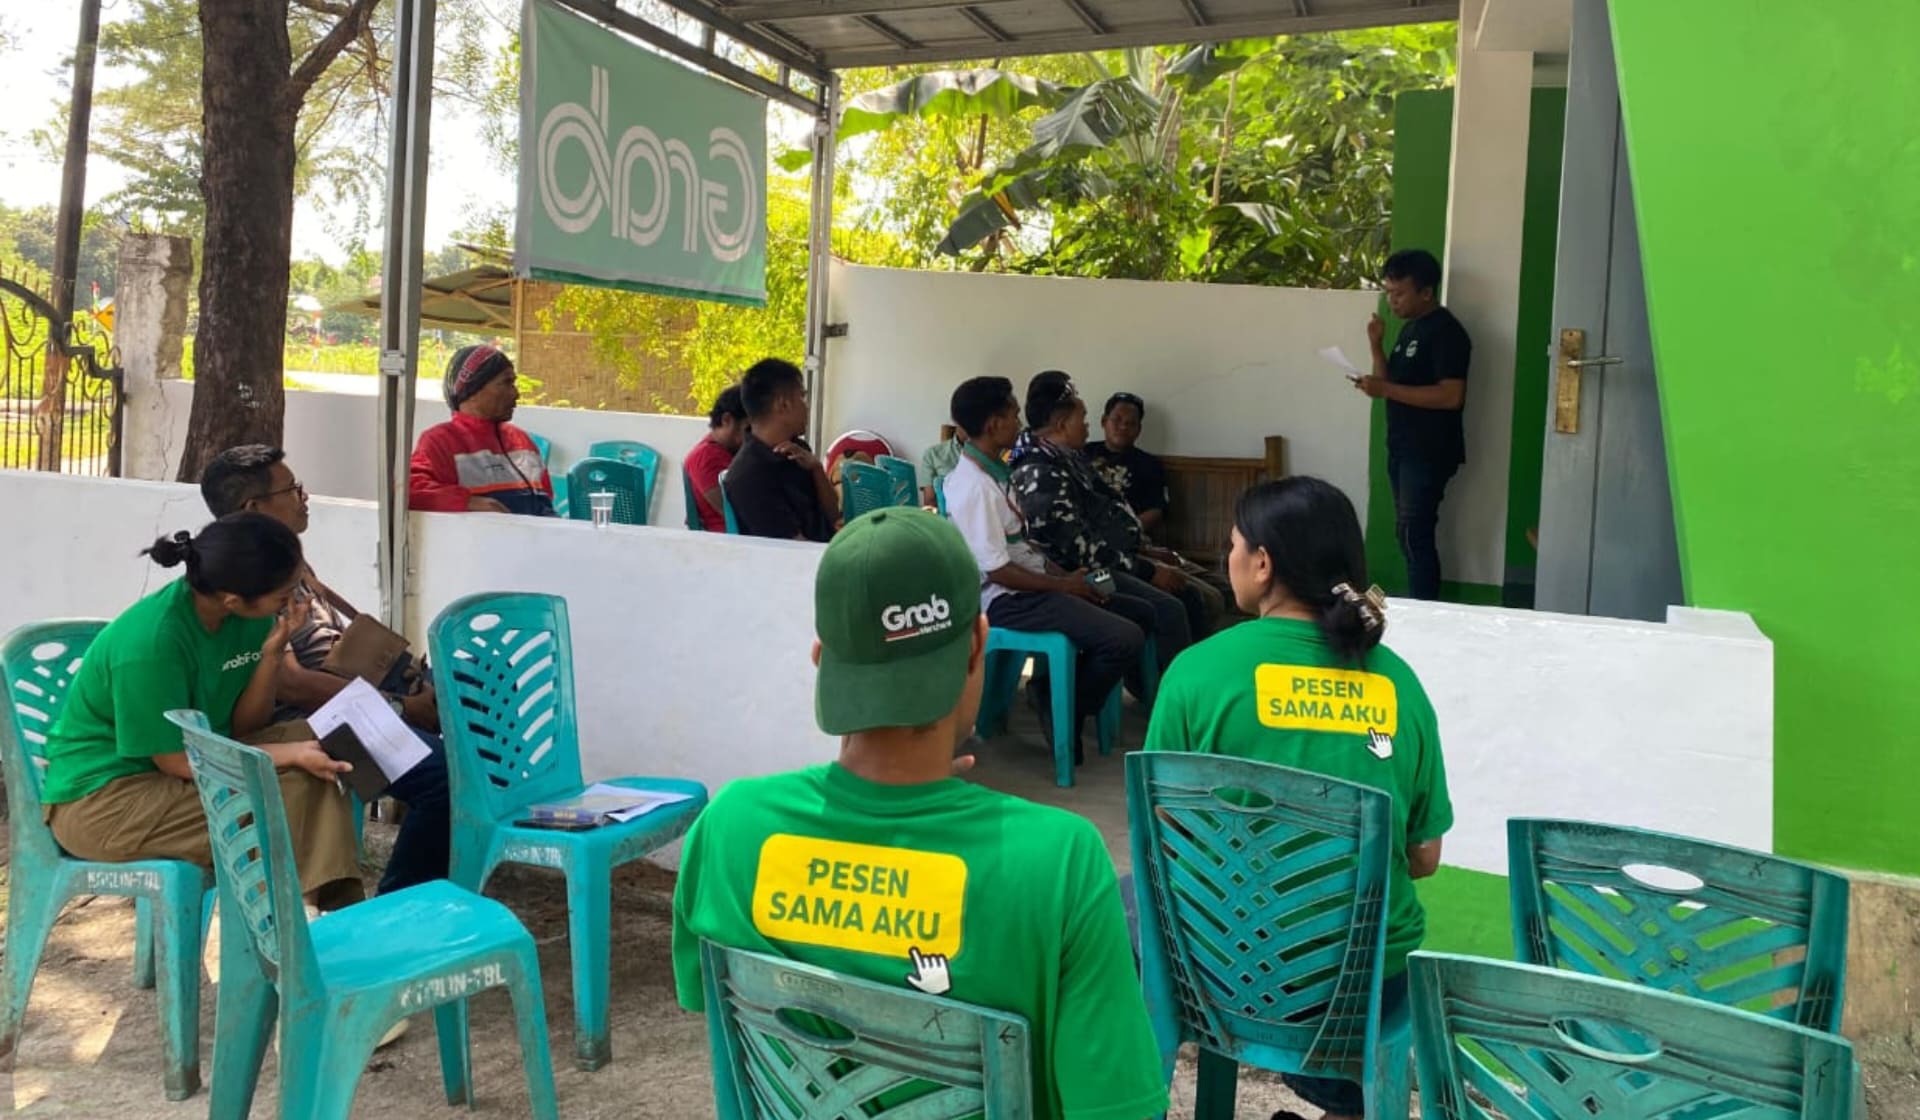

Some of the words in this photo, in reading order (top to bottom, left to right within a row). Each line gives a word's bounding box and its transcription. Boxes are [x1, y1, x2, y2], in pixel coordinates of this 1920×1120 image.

[881, 592, 950, 631] Grab
[1292, 676, 1364, 700] PESEN
[1269, 697, 1335, 721] SAMA
[1340, 703, 1387, 726] AKU
[807, 857, 909, 898] PESEN
[768, 890, 864, 932] SAMA
[871, 905, 940, 941] AKU
